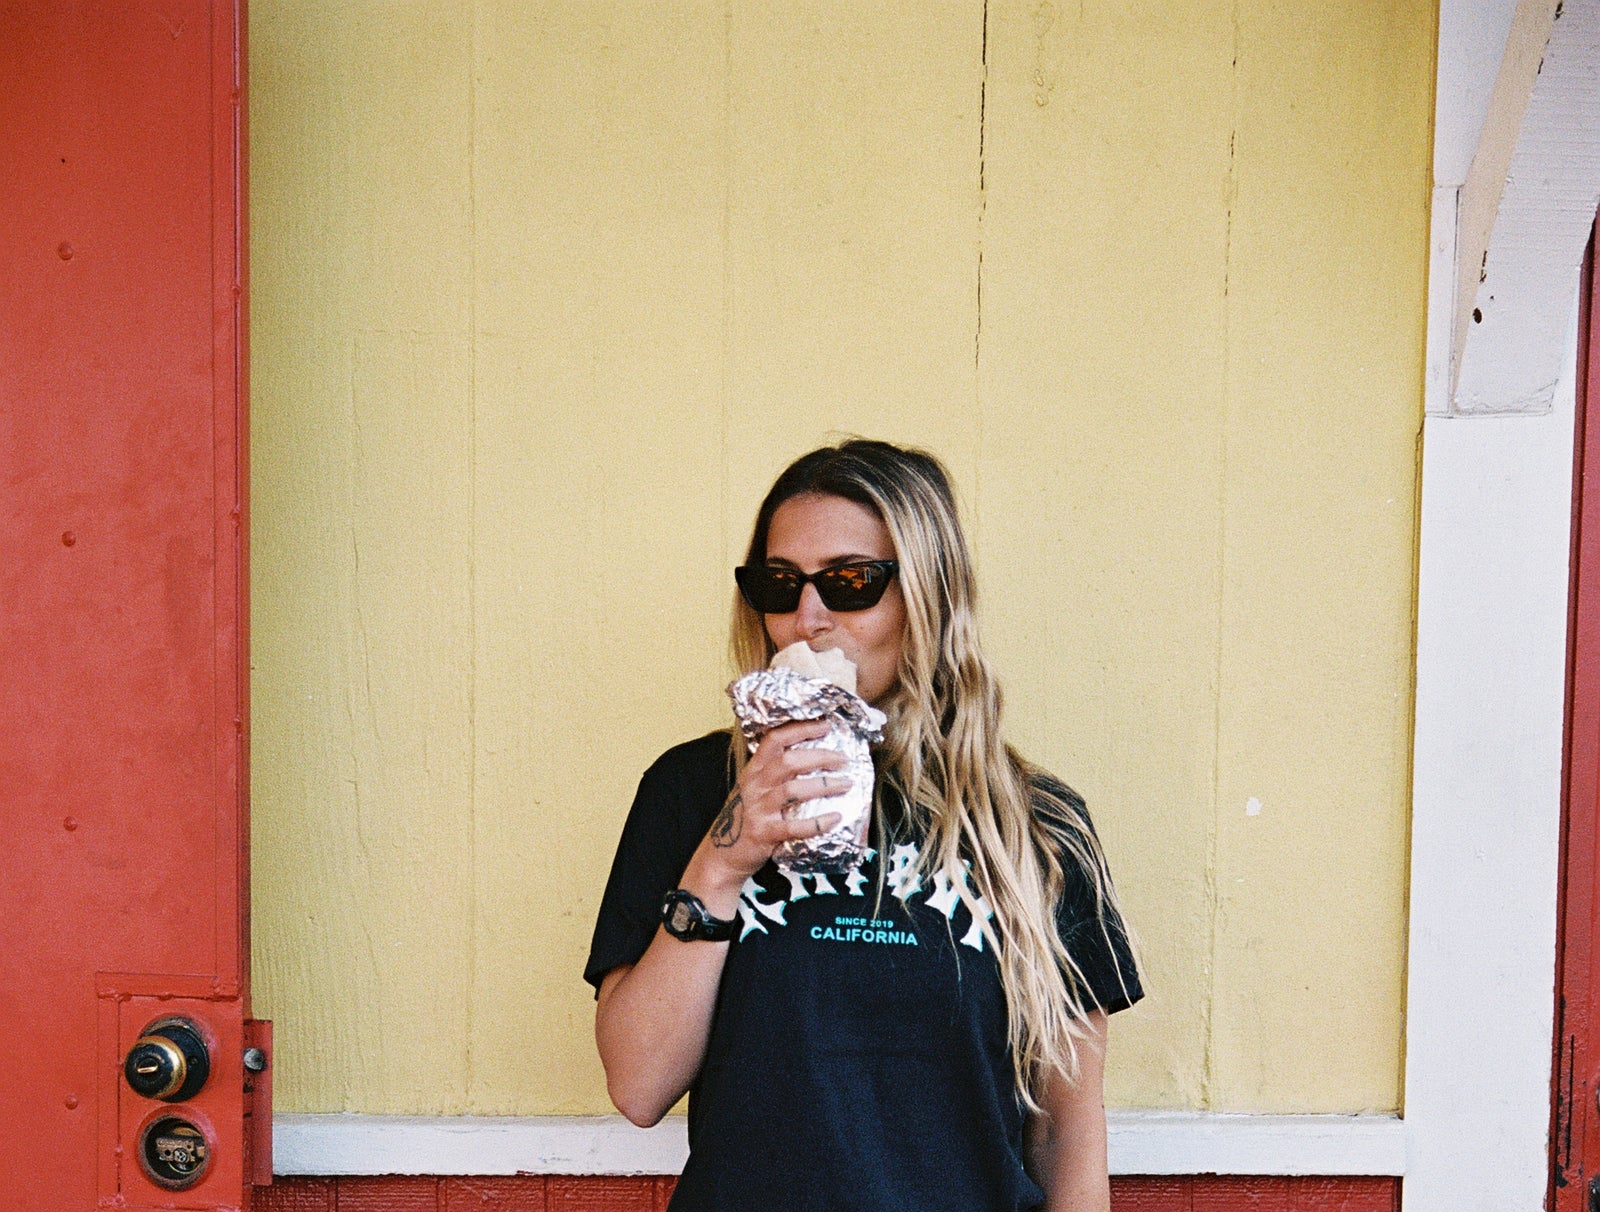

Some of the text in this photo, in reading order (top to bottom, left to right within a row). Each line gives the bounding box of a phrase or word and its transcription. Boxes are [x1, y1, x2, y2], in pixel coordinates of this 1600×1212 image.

[835, 916, 894, 929] SINCE 2019
[810, 926, 919, 946] CALIFORNIA
